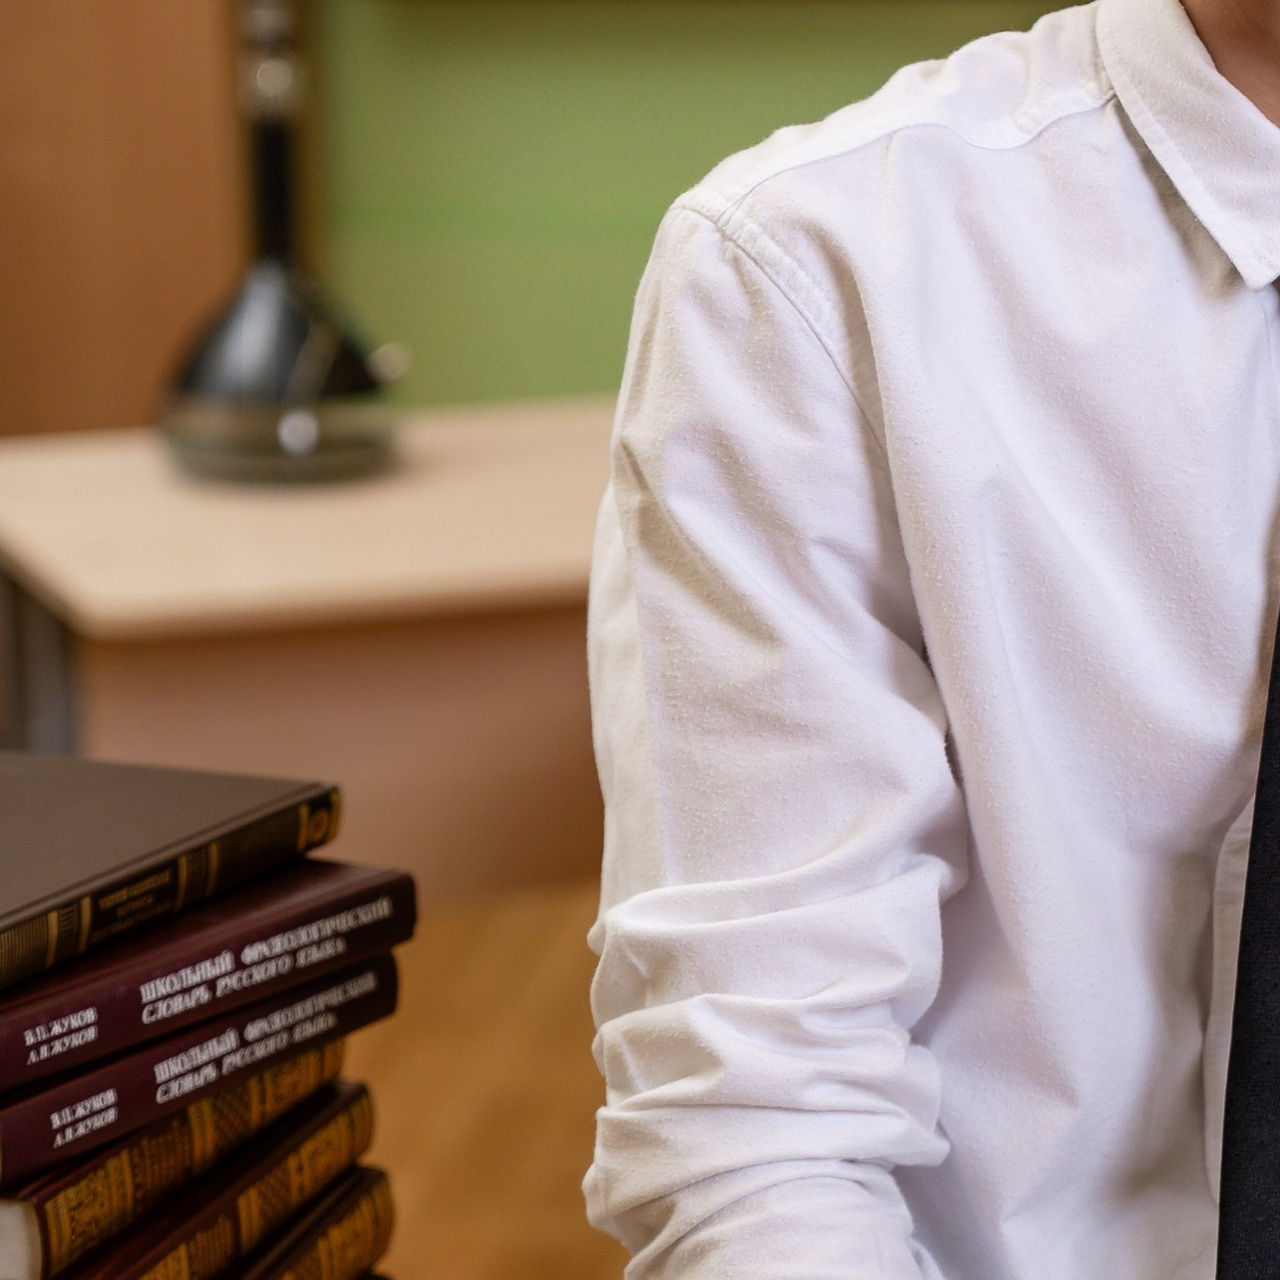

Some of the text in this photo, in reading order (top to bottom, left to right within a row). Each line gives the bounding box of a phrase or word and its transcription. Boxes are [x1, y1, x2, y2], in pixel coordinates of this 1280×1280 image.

[139, 949, 236, 1004] ШКОЛЬНЫЙ
[141, 983, 213, 1025] СЛОВАРЬ
[215, 952, 295, 998] РУССКОГО
[153, 1027, 240, 1084] ШКОЛЬНЫЙ
